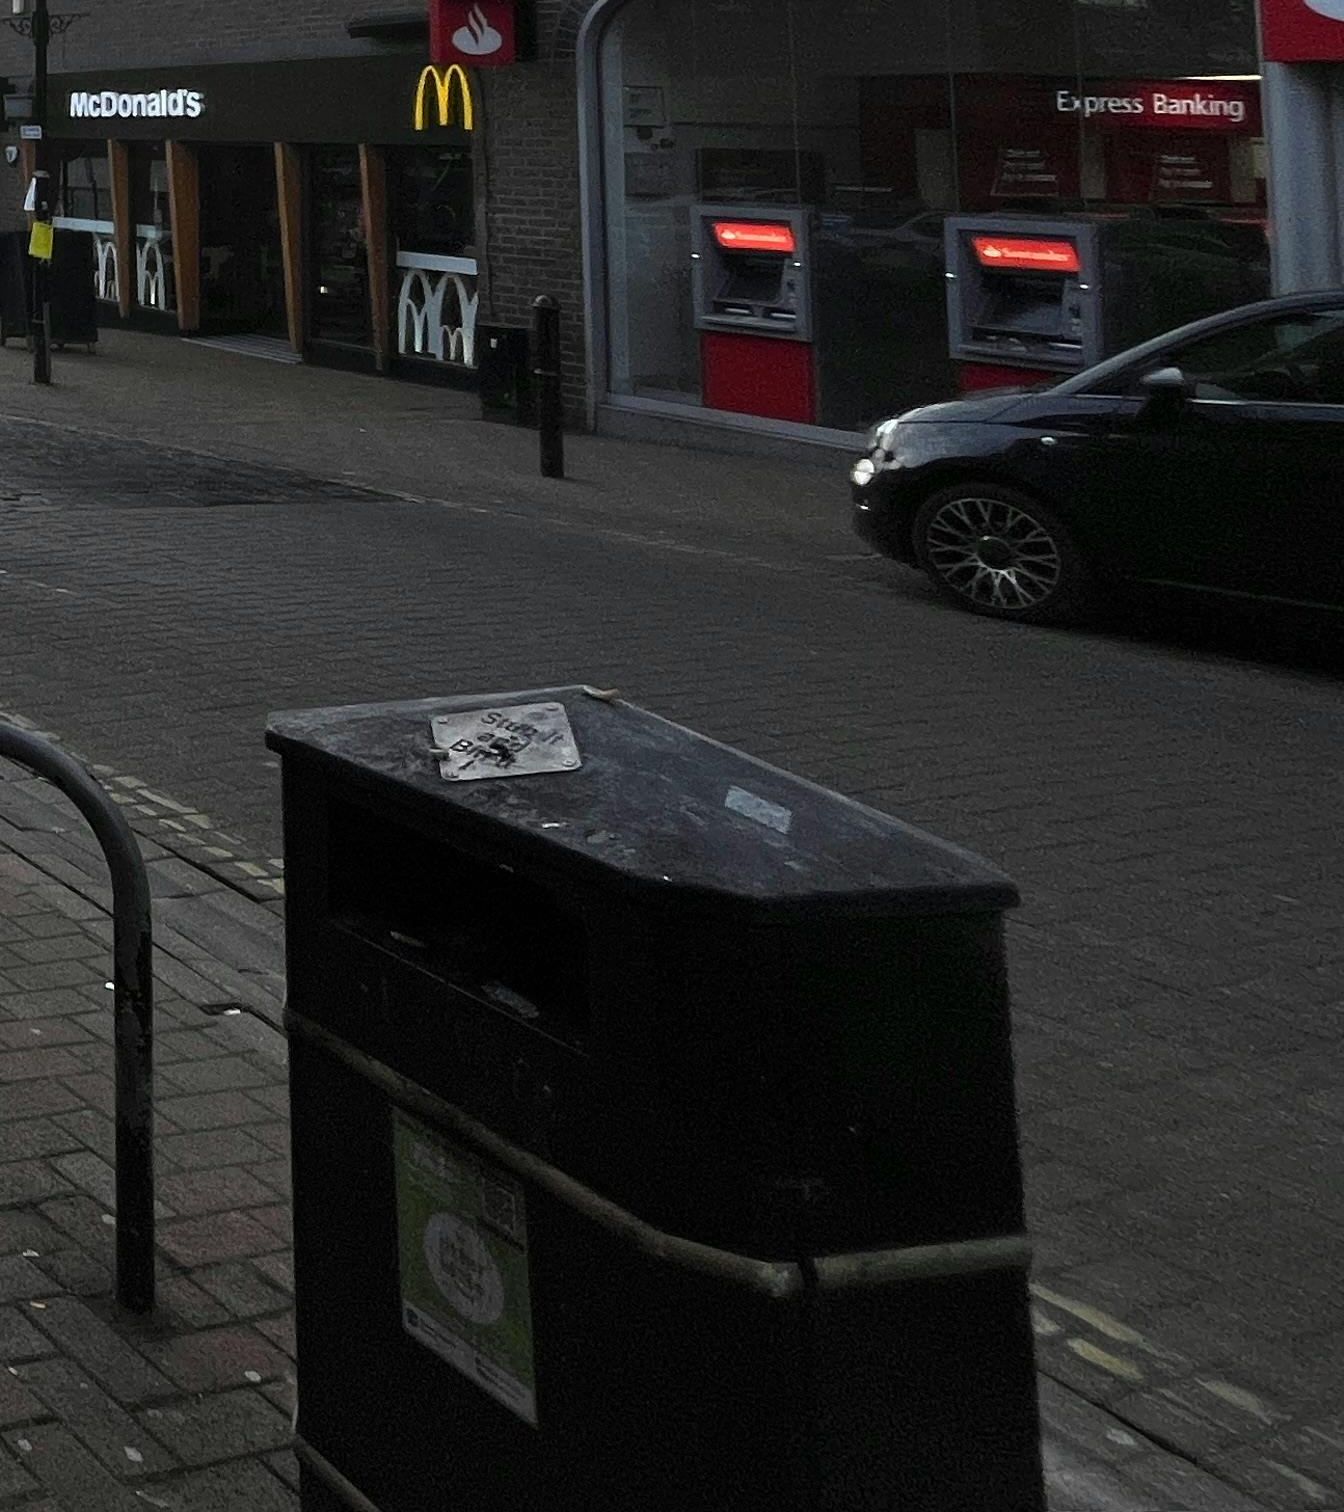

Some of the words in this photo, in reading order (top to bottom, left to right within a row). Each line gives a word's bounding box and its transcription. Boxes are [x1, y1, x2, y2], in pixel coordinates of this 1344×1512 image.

[70, 89, 204, 118] McDonald's
[1056, 90, 1144, 117] Express
[1152, 93, 1245, 122] Banking
